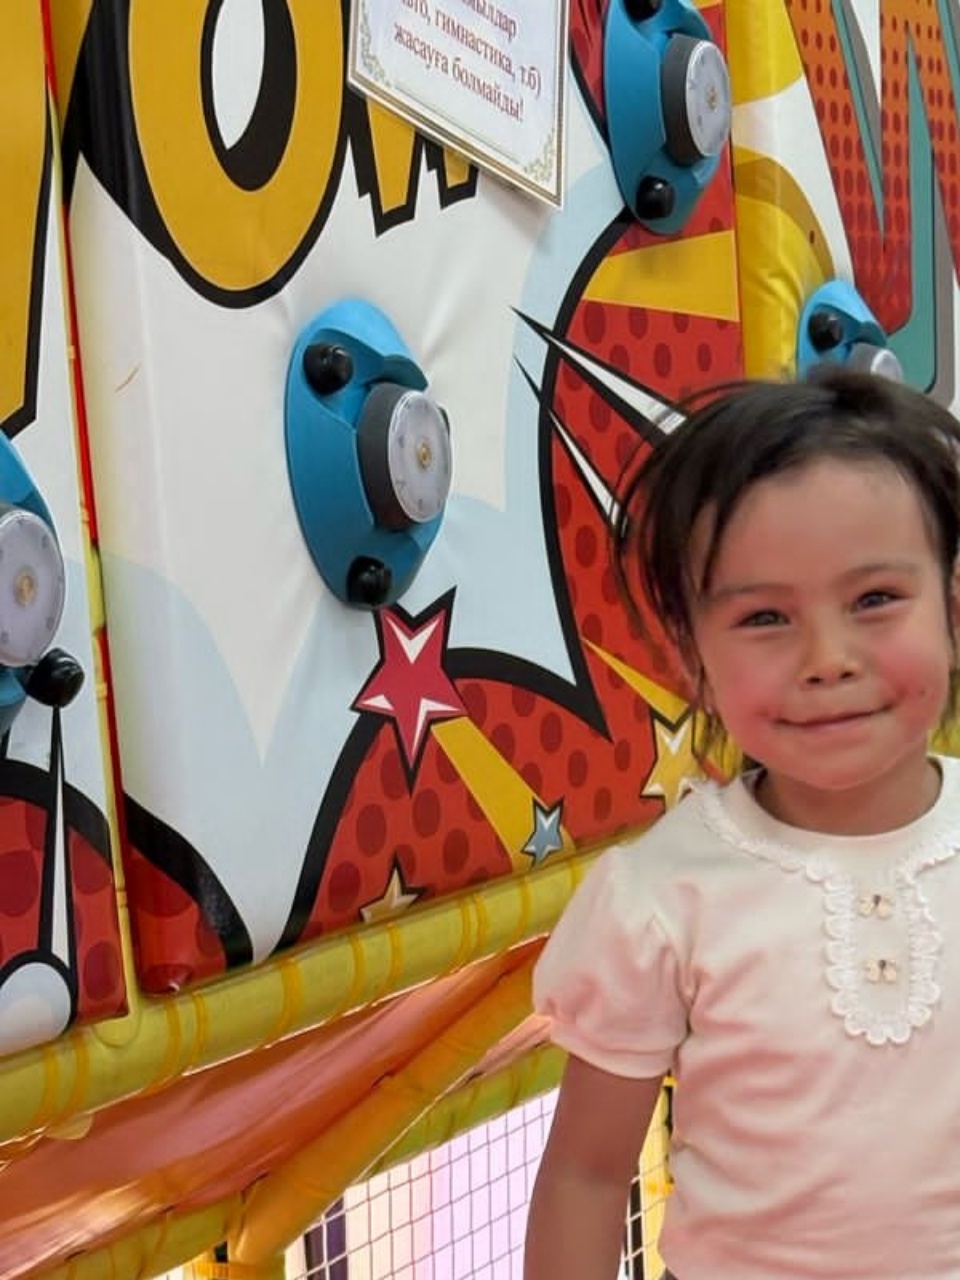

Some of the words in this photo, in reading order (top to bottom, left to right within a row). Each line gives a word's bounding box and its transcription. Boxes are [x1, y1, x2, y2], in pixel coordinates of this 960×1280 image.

[393, 22, 450, 75] жасауға
[452, 57, 525, 122] болмайды!
[434, 10, 516, 82] гимнастика,
